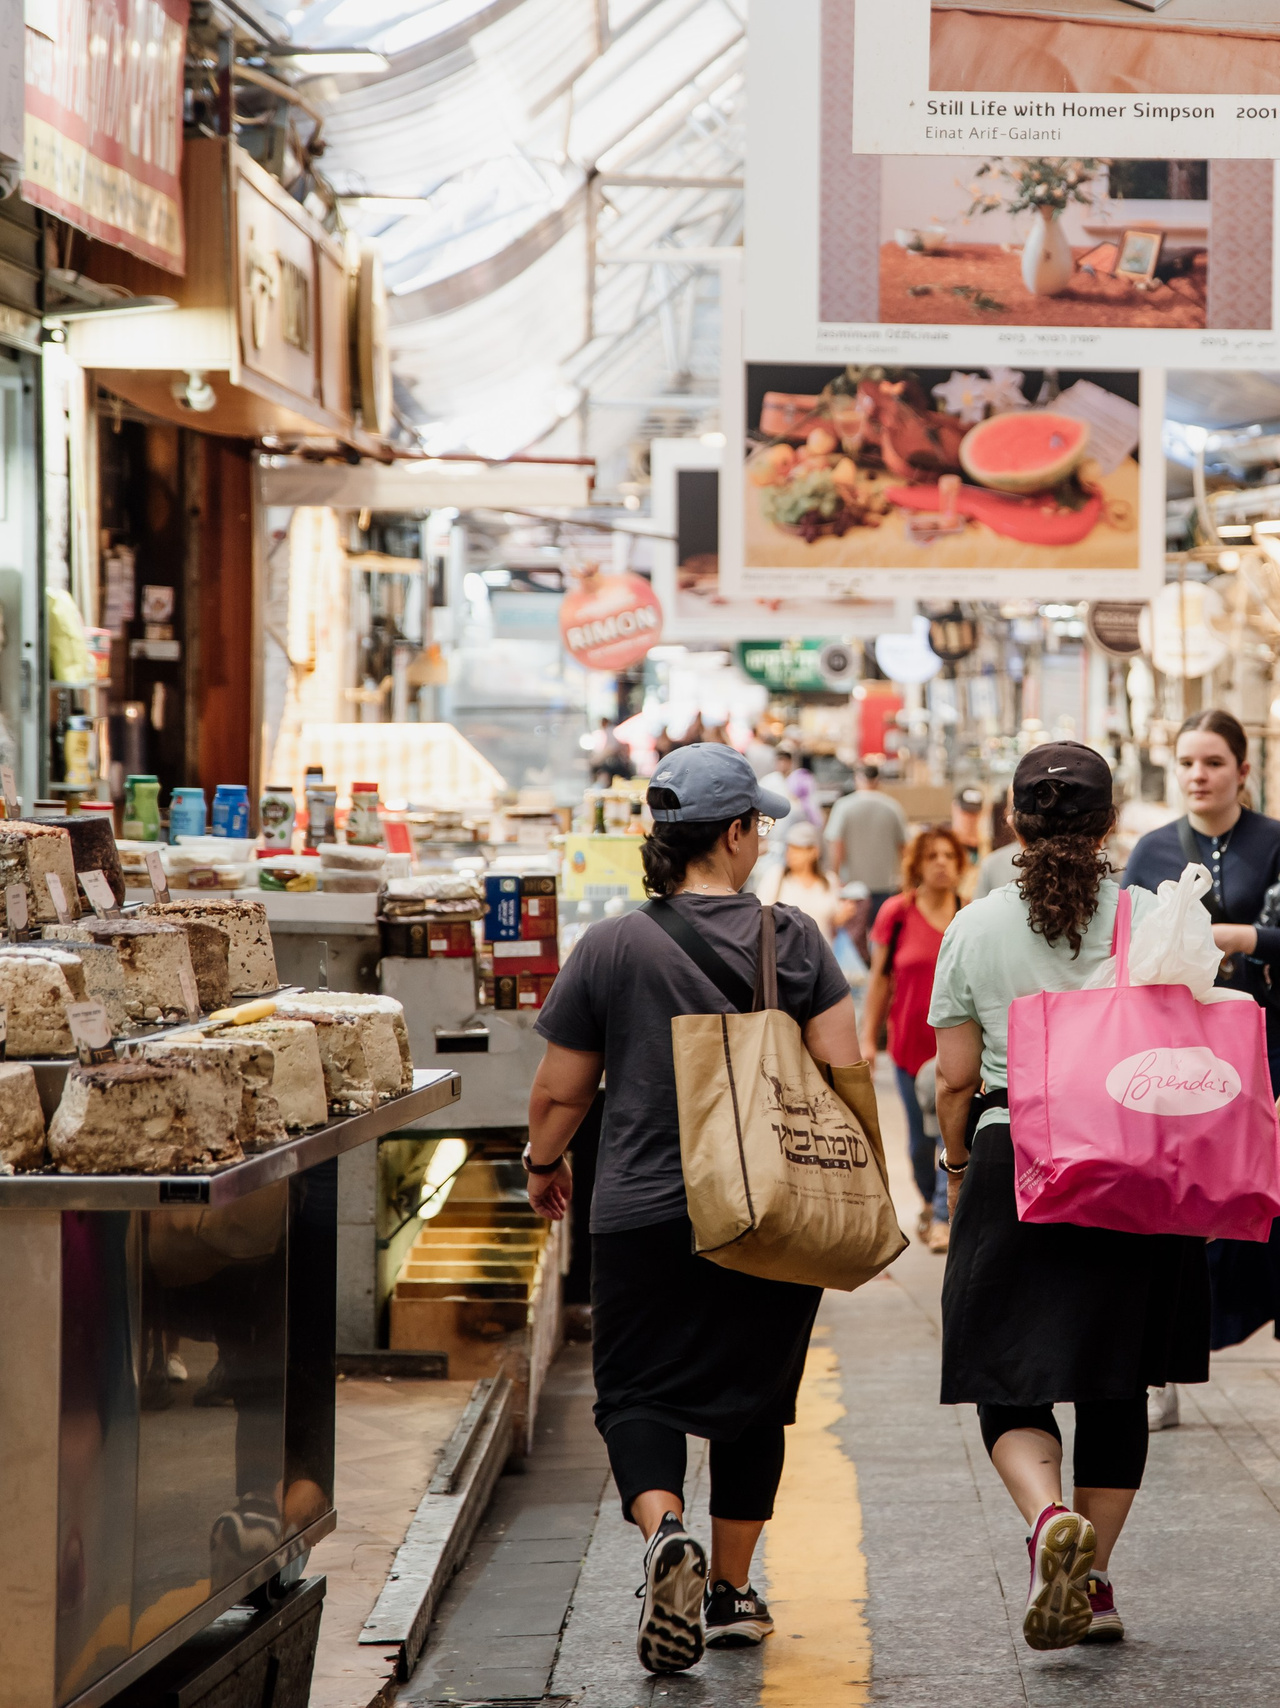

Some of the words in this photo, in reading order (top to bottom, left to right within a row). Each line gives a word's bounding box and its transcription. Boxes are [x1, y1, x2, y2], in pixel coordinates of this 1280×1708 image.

[927, 100, 963, 116] Still
[971, 100, 1007, 117] Life
[1013, 102, 1056, 117] with
[1062, 102, 1127, 118] Homer
[1133, 103, 1215, 122] Simpson
[1236, 107, 1278, 119] 2001
[925, 126, 963, 139] Einat
[968, 126, 1062, 141] Arif-Galanti
[566, 604, 657, 652] RIMON
[1120, 1051, 1230, 1105] Brenda's
